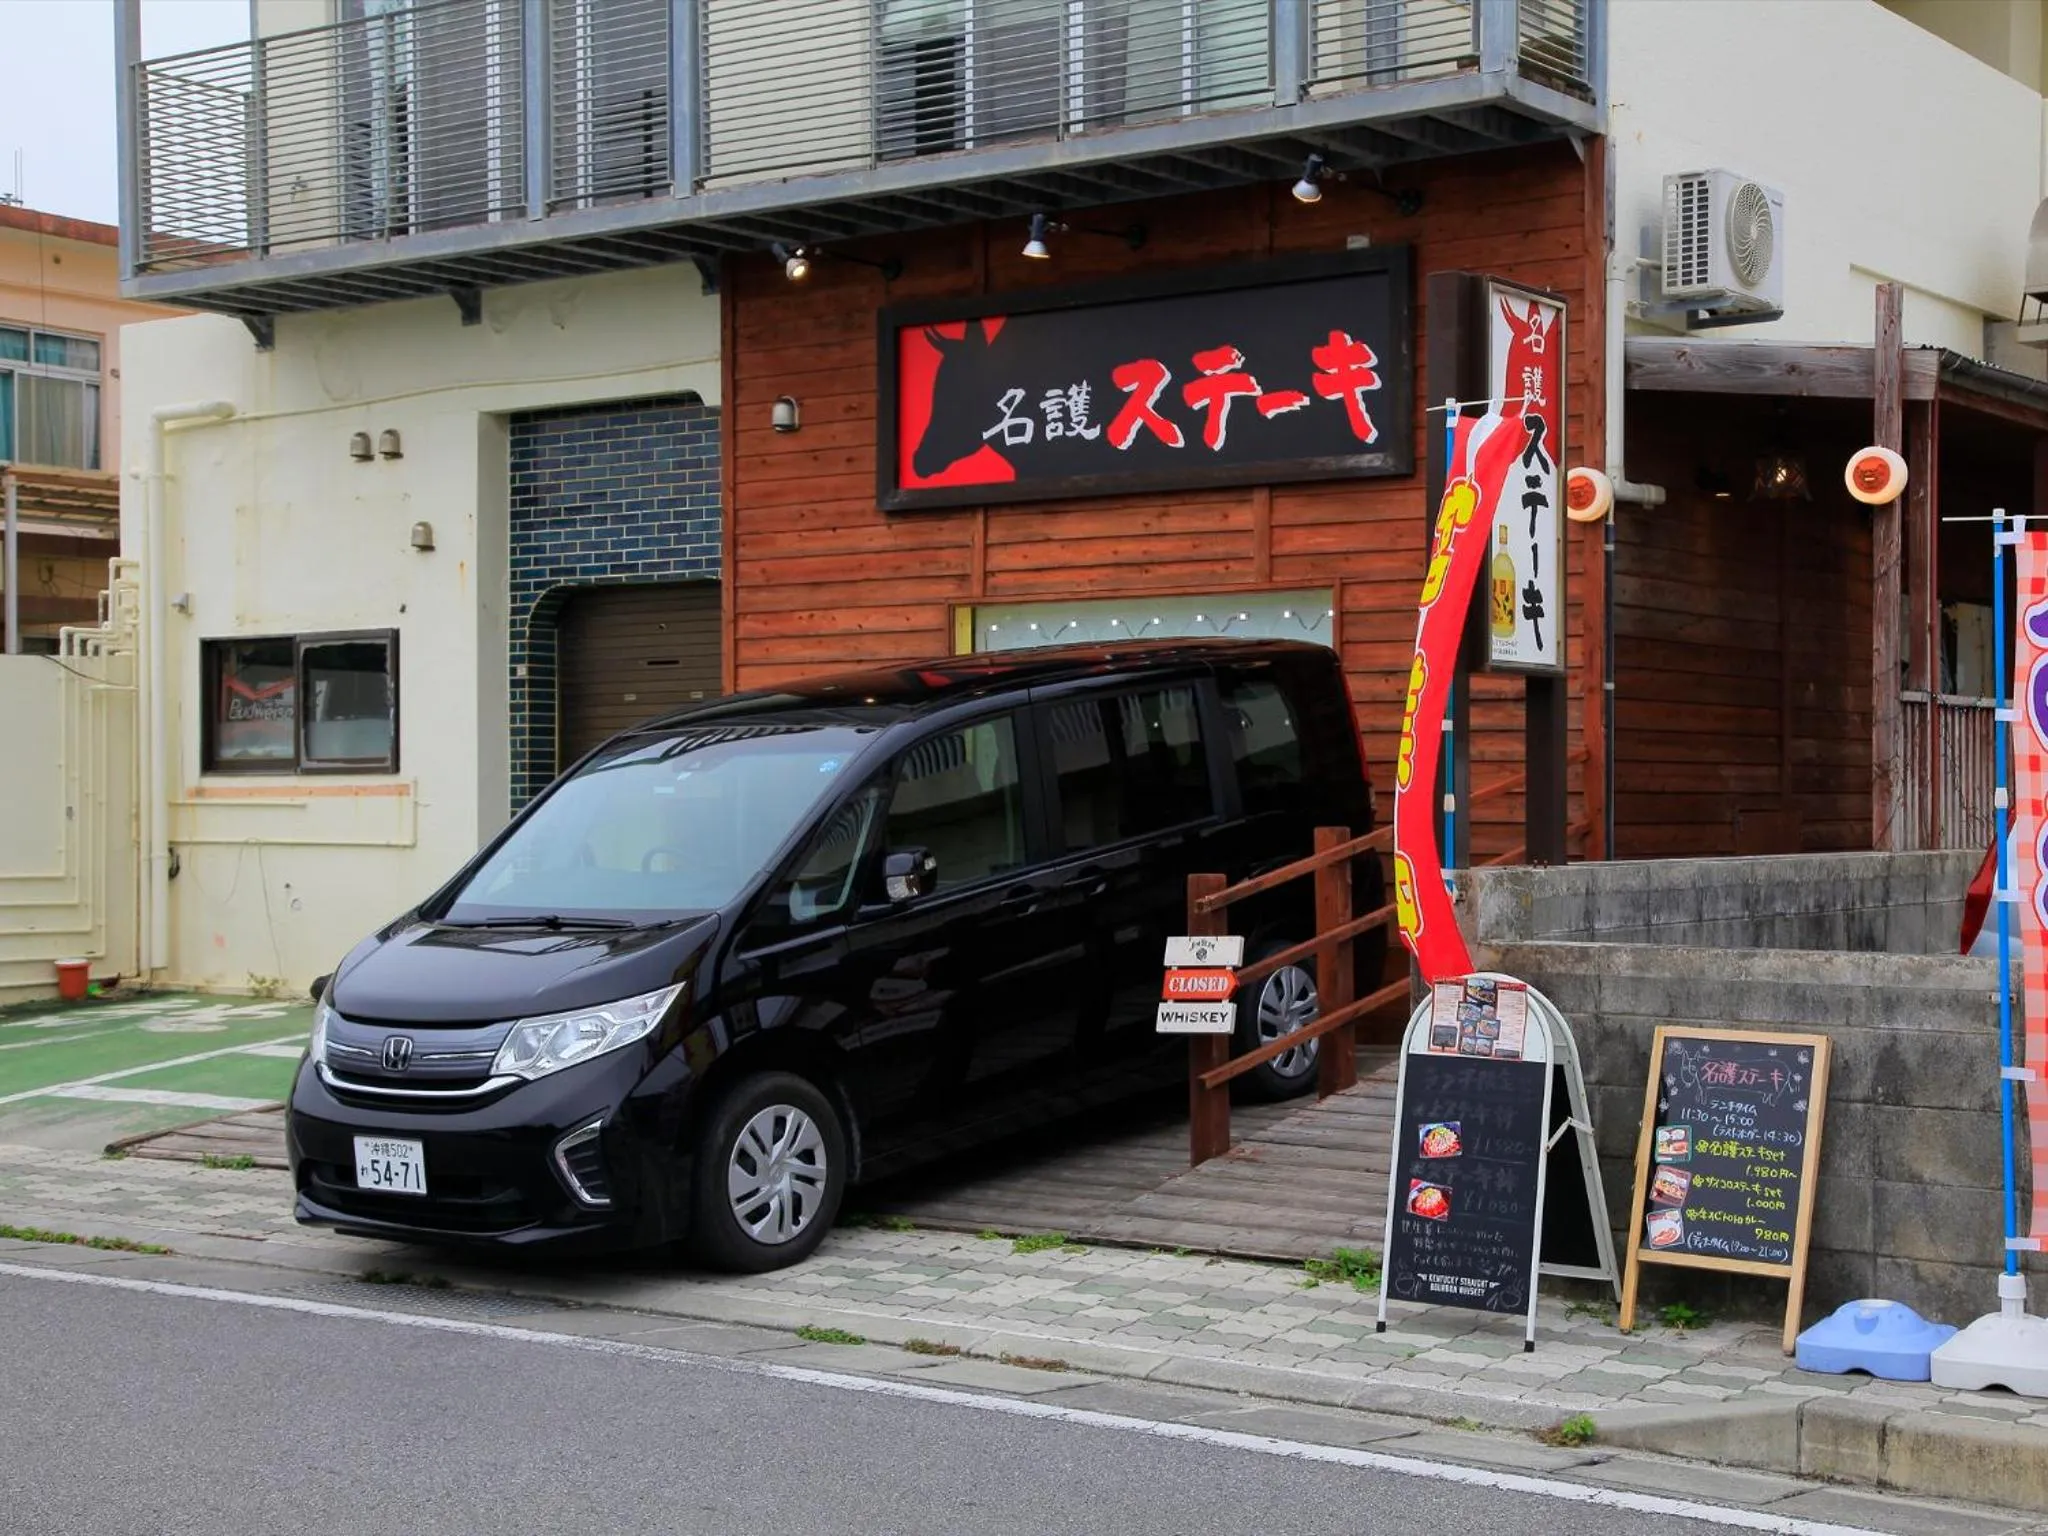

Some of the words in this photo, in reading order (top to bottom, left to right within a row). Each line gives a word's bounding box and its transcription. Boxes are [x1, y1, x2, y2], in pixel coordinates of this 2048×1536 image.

[982, 330, 1382, 451] 名護ステーキ
[1521, 312, 1550, 652] 名護ステーキ
[1168, 976, 1230, 993] CLOSED
[1160, 1011, 1229, 1024] WHISKEY
[1700, 1060, 1785, 1092] 名護ステーキ
[370, 1159, 420, 1189] 54-71
[1754, 1228, 1790, 1242] 980円
